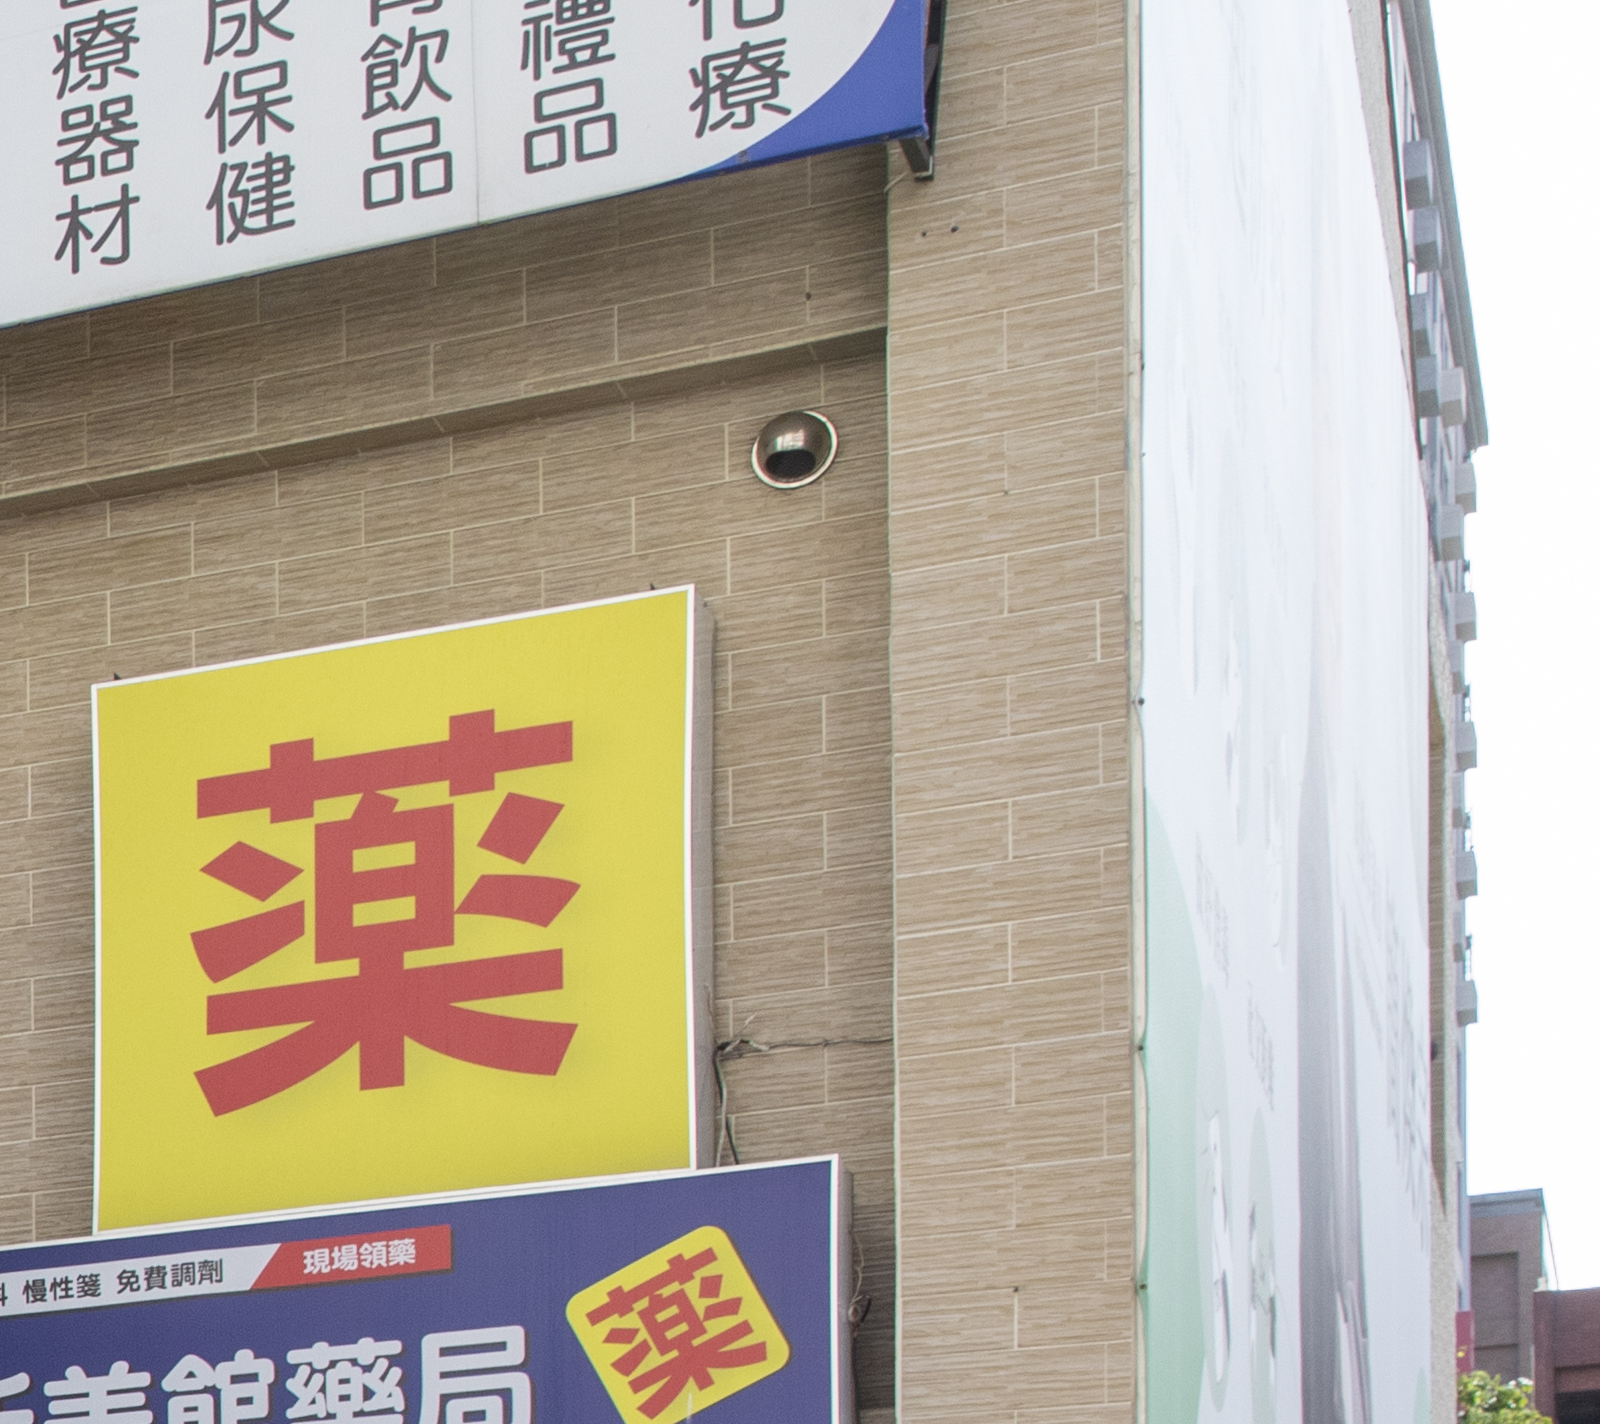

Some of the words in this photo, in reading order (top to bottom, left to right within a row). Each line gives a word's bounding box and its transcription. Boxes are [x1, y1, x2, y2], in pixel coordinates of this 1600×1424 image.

[53, 0, 140, 274] 療器材
[303, 1237, 416, 1275] 現場領藥
[23, 1271, 101, 1305] 慢性箋
[117, 1257, 224, 1296] 免費調劑
